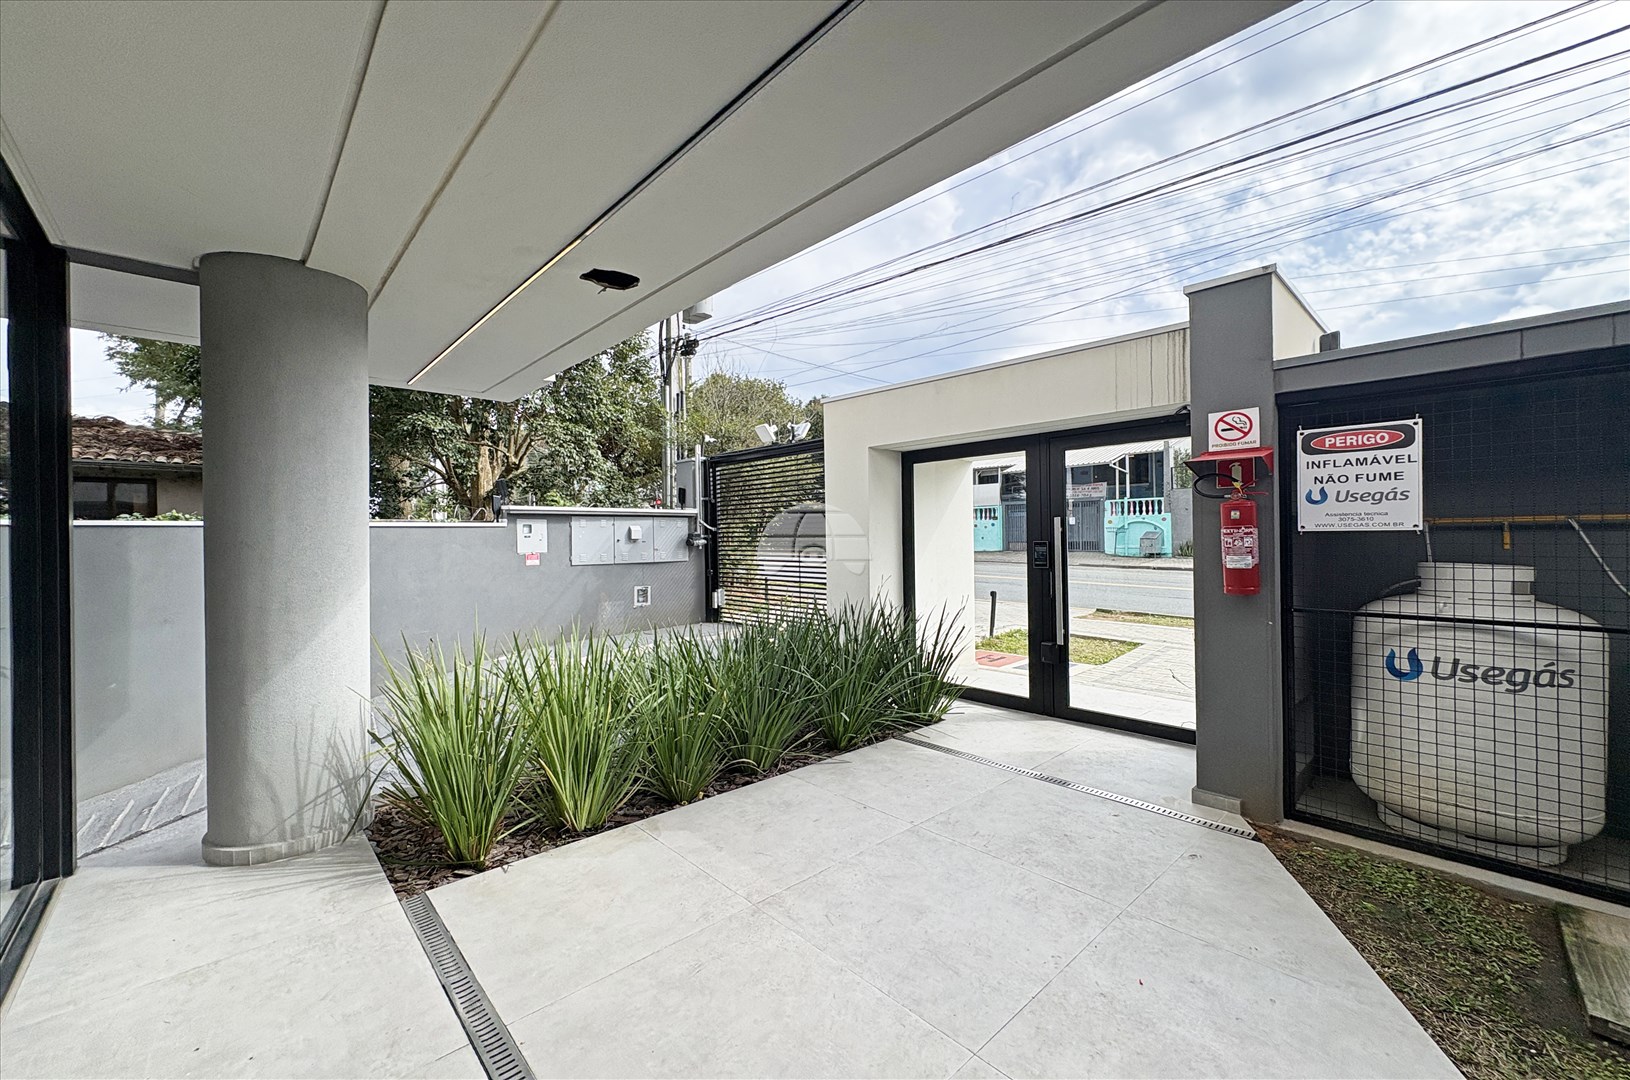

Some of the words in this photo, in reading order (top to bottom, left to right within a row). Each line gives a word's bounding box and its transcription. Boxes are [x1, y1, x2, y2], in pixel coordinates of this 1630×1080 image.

[1324, 432, 1389, 448] PERIGO
[1306, 454, 1418, 470] INFLAMÁVEL
[1313, 473, 1350, 485] NÃO
[1354, 471, 1405, 483] FUME
[1334, 486, 1411, 506] Usegás
[1430, 656, 1576, 694] Usegás
